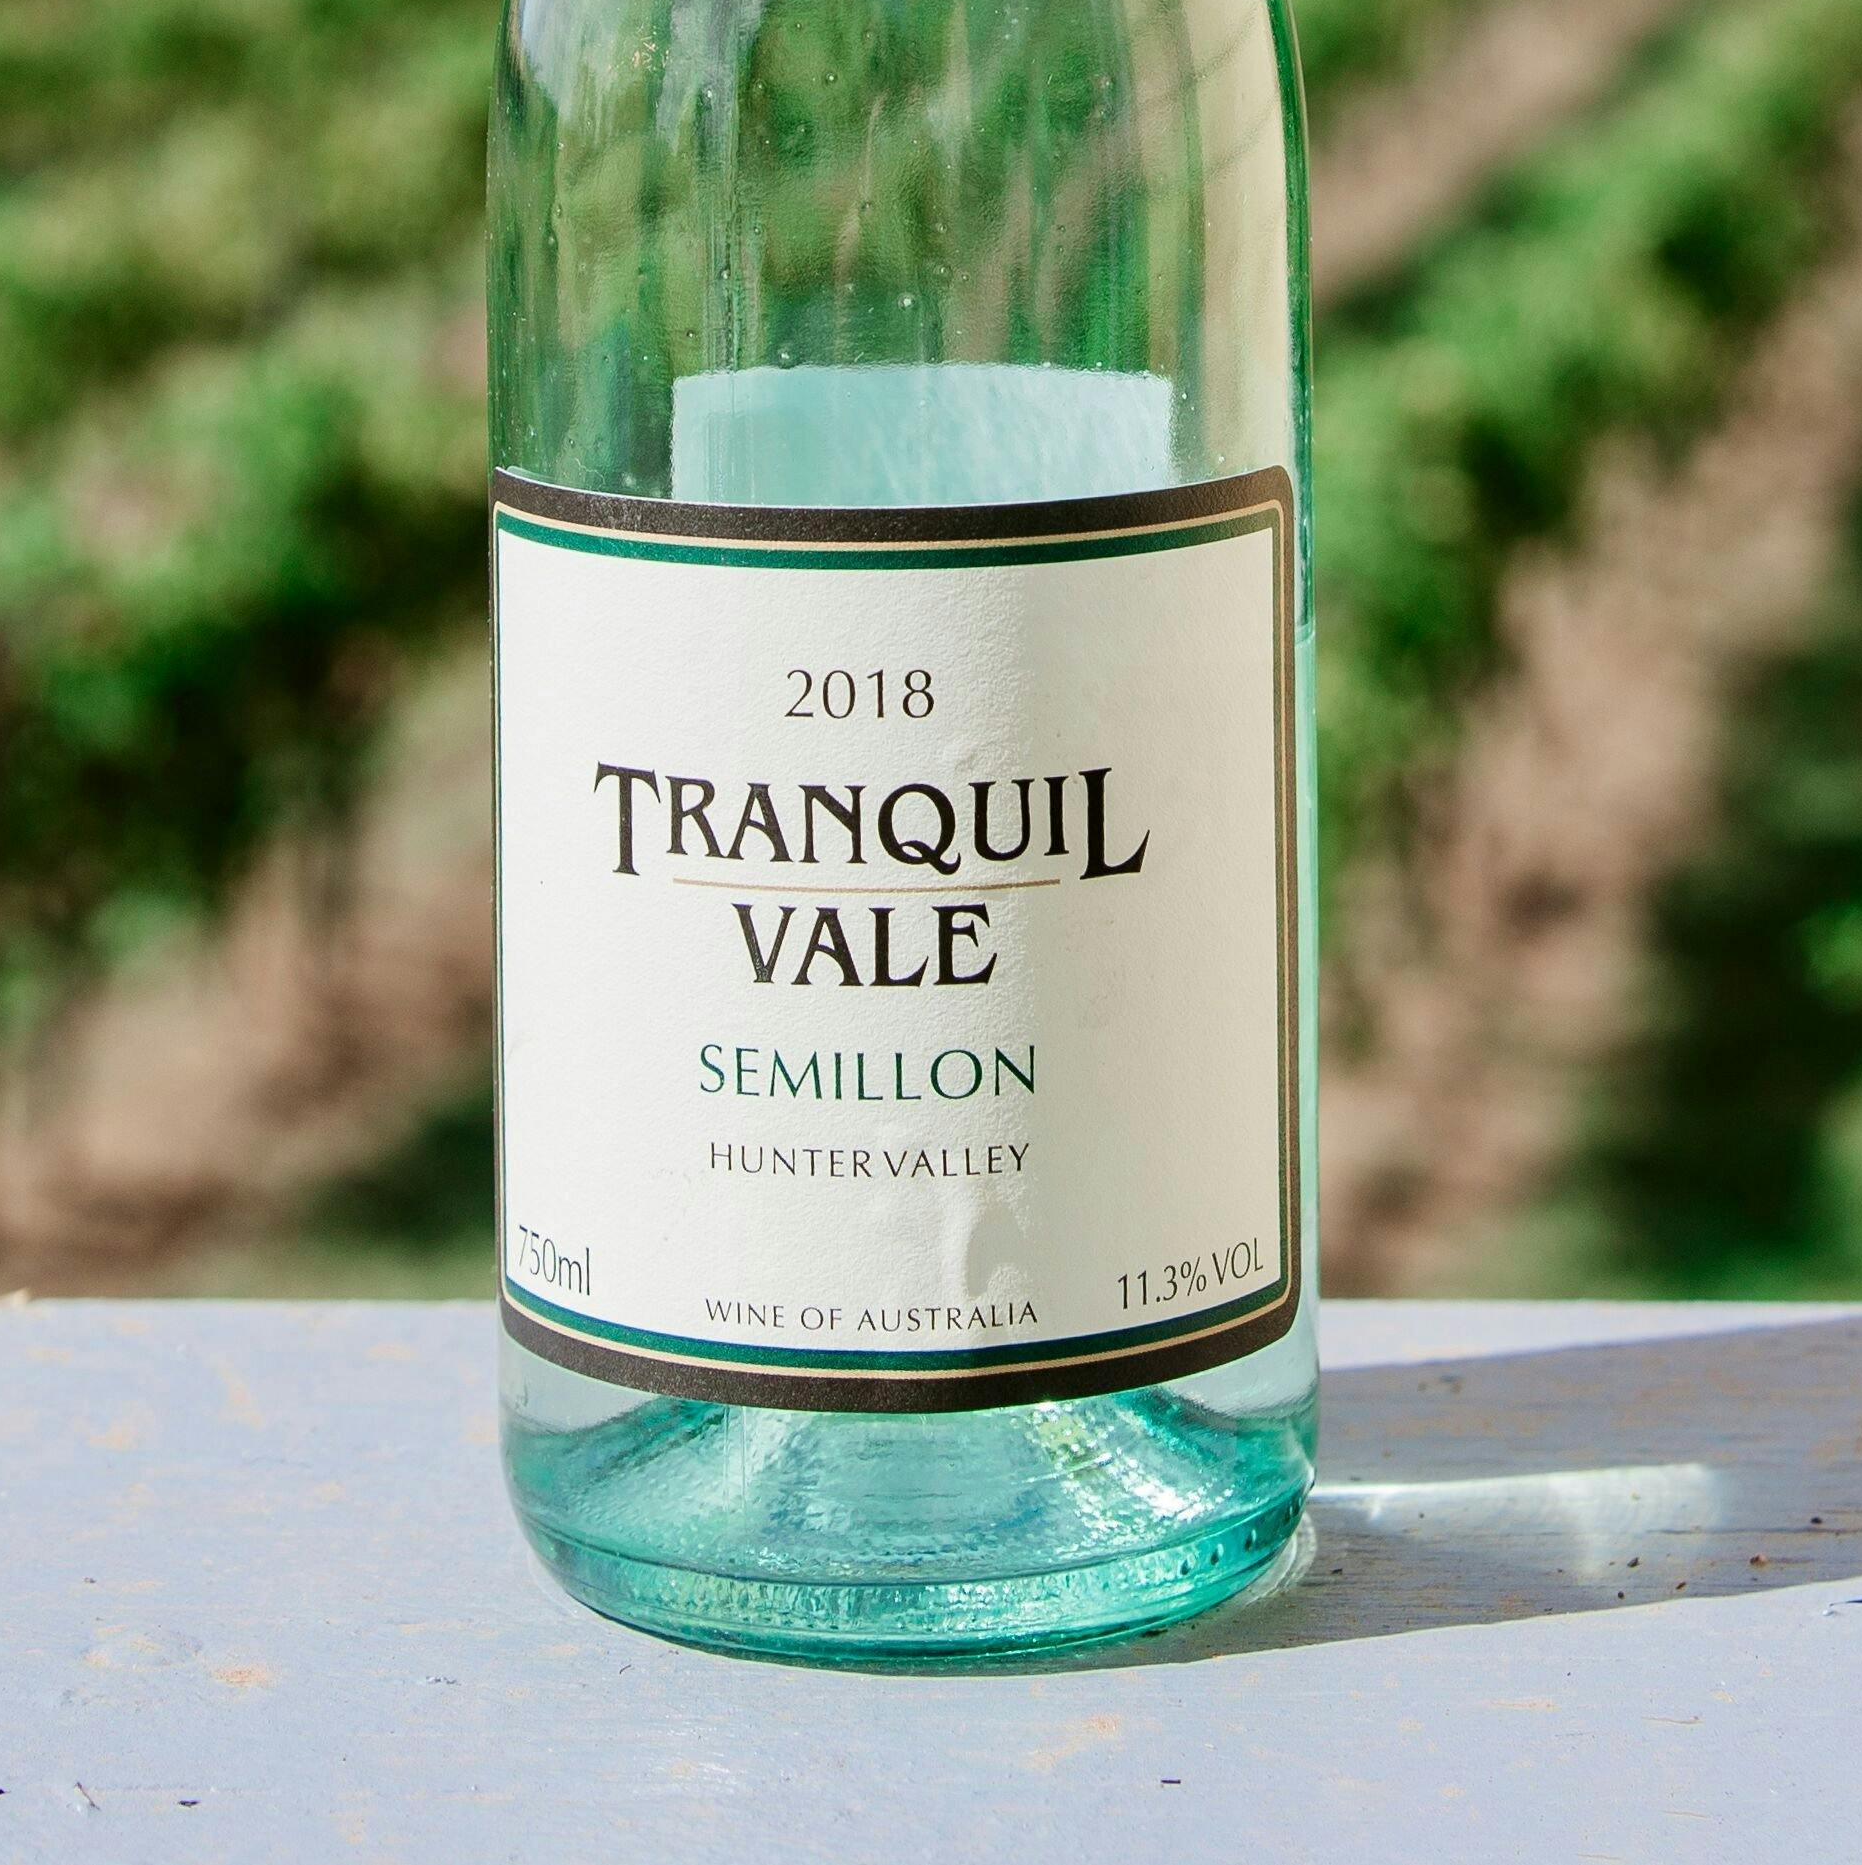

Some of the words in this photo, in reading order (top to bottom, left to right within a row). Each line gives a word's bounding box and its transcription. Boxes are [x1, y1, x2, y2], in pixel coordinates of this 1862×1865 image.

[784, 669, 935, 720] 2018
[593, 761, 1151, 879] TRANQUIL
[731, 902, 998, 988] VALE
[700, 1044, 1036, 1101] SEMILLON
[710, 1141, 872, 1178] HUNTER
[883, 1142, 1030, 1178] VALLEY
[518, 1224, 591, 1296] 750ml
[1117, 1256, 1207, 1310] 11.3%
[1211, 1237, 1264, 1286] VOL
[705, 1298, 785, 1329] WINE
[800, 1306, 842, 1331] OF
[857, 1300, 1038, 1332] AUSTRALIA
